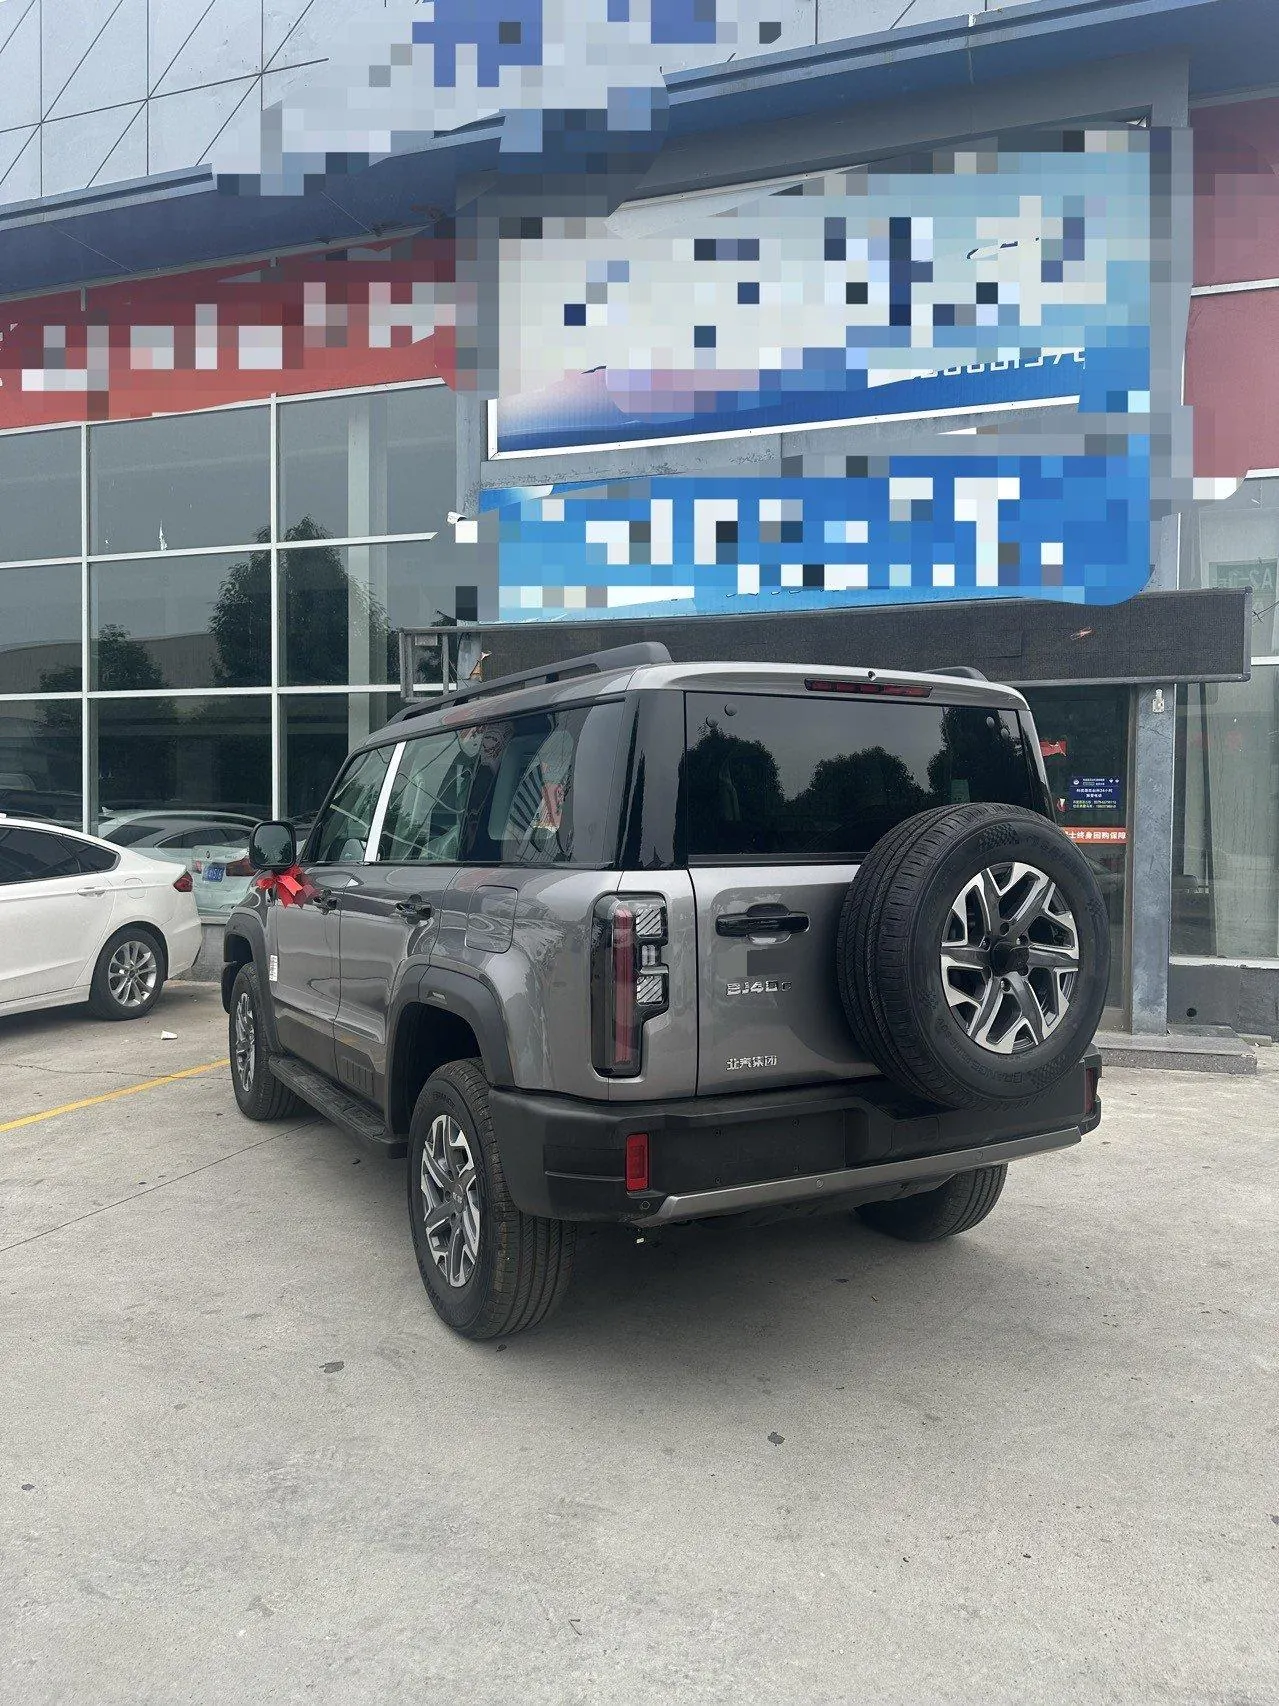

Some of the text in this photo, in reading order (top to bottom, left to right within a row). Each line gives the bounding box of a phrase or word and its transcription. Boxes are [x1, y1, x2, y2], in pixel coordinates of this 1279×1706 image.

[1064, 830, 1127, 840] 士终身回购保障
[726, 1055, 778, 1071] 北汽集团
